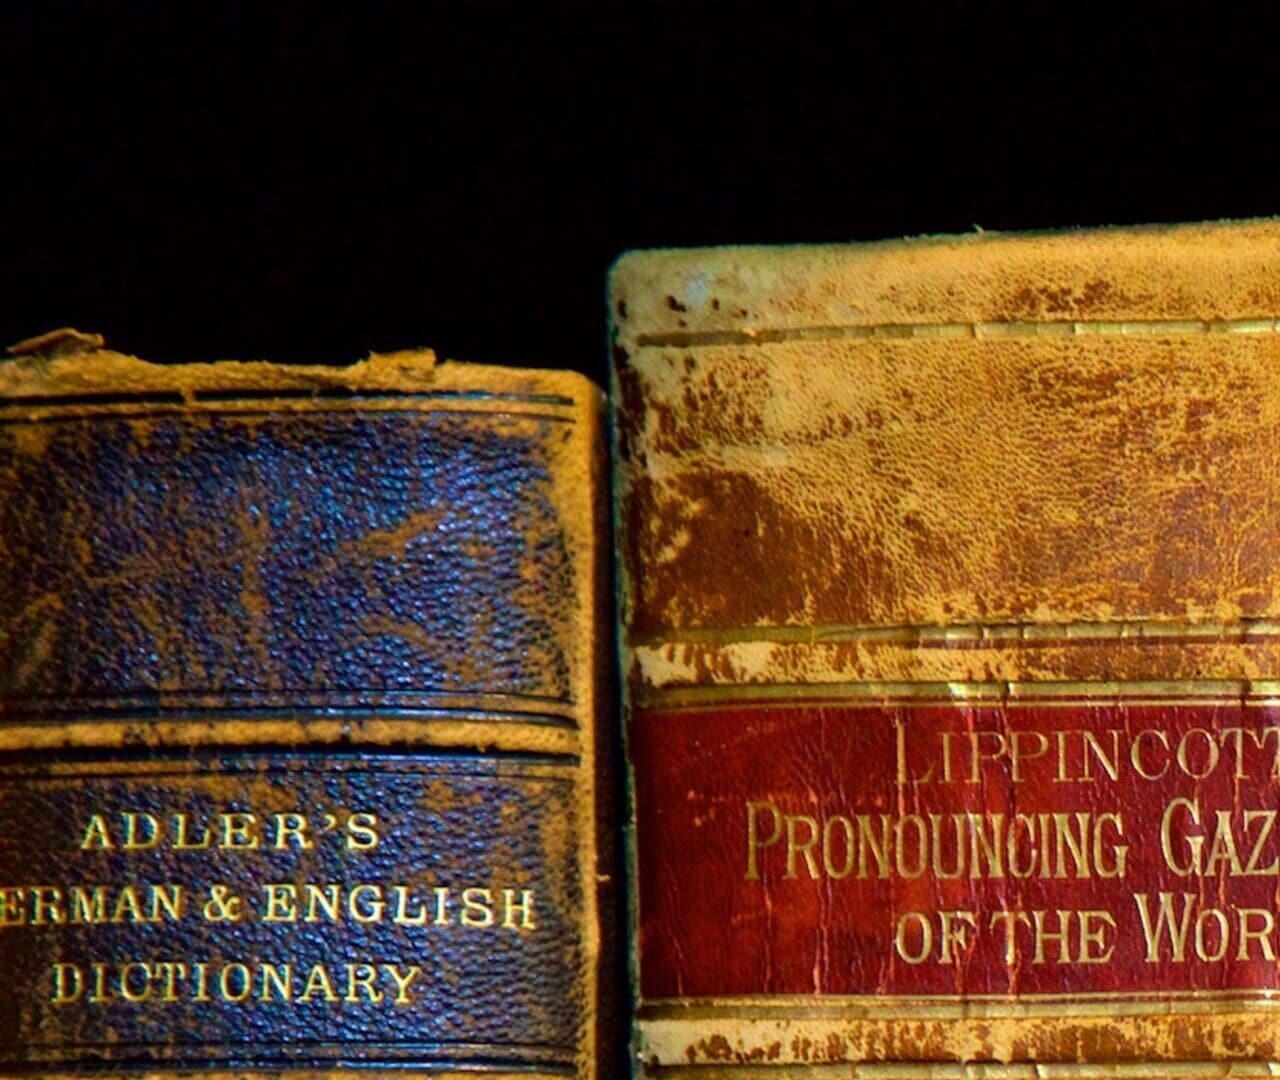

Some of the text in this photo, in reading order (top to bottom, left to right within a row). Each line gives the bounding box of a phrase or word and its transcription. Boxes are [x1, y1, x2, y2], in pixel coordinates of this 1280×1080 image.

[80, 812, 379, 850] ADLER'S
[744, 801, 1128, 880] PRONOUNCING
[203, 885, 241, 921] &
[263, 882, 537, 930] ENGLISH
[895, 911, 976, 964] OF
[989, 910, 1117, 964] THE
[51, 962, 420, 1004] DICTIONARY
